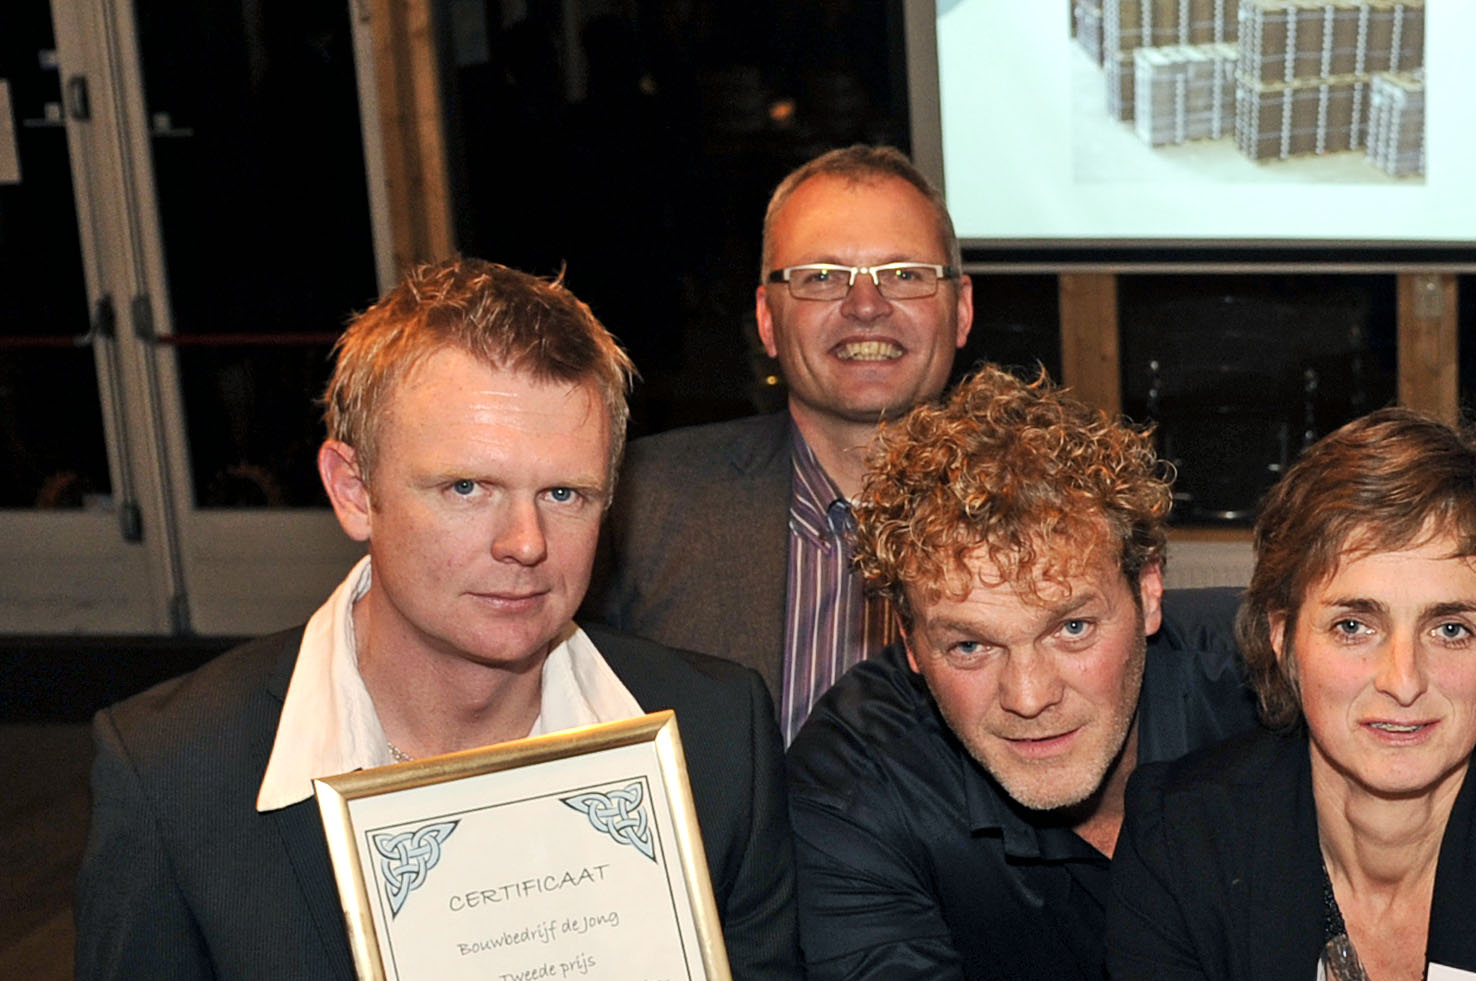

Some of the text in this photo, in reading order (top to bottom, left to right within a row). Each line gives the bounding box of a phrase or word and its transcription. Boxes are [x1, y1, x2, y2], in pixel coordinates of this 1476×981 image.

[448, 863, 610, 912] CERTIFICAAT
[457, 920, 558, 956] Bouwbedrijf
[561, 952, 597, 980] prijs
